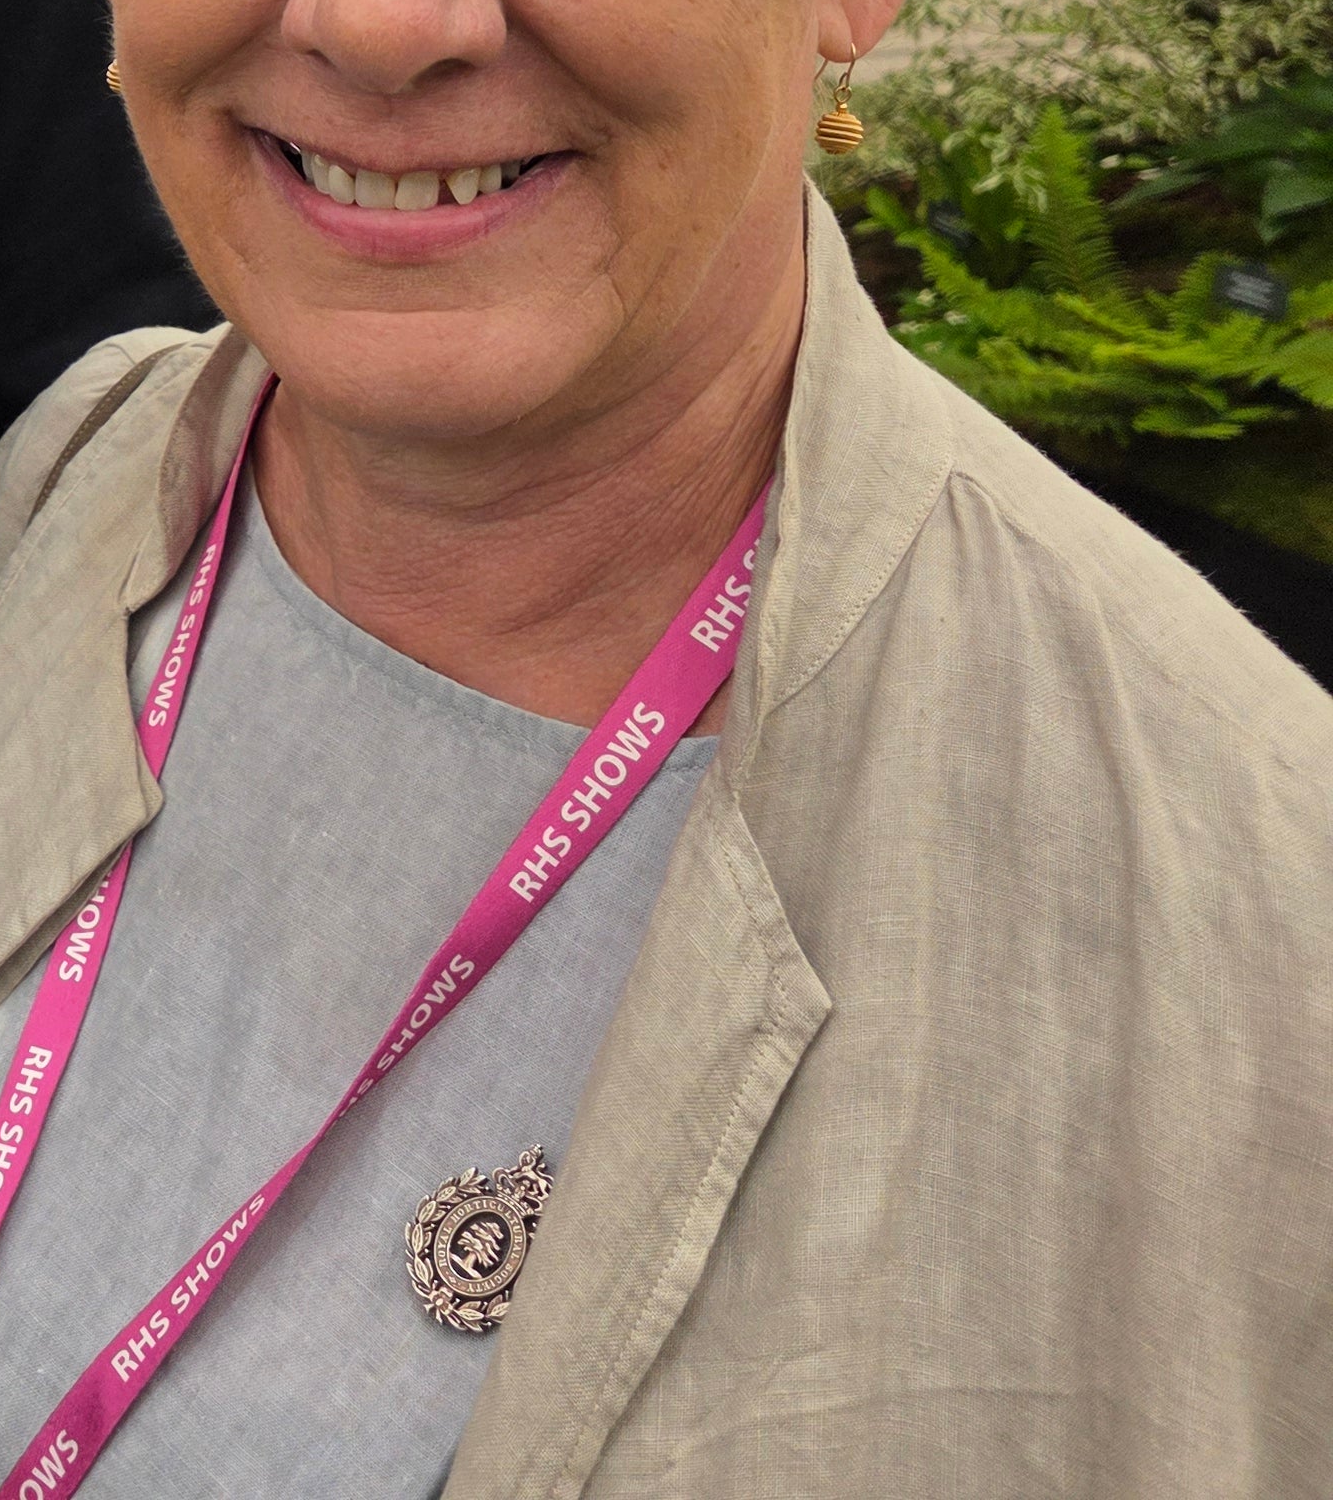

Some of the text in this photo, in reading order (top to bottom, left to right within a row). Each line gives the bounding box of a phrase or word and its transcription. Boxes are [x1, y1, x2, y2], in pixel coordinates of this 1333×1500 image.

[148, 544, 217, 727] RHS SHOWS
[690, 574, 753, 653] RHS
[508, 701, 666, 904] RHS SHOWS
[59, 870, 111, 982] OWS
[376, 953, 476, 1072] SHOWS
[9, 1044, 53, 1116] RHS
[110, 1194, 265, 1383] RHS SHOWS
[437, 1199, 525, 1293] ROYAL HORTICULTURAL SOCIETY
[19, 1429, 79, 1500] OWS
